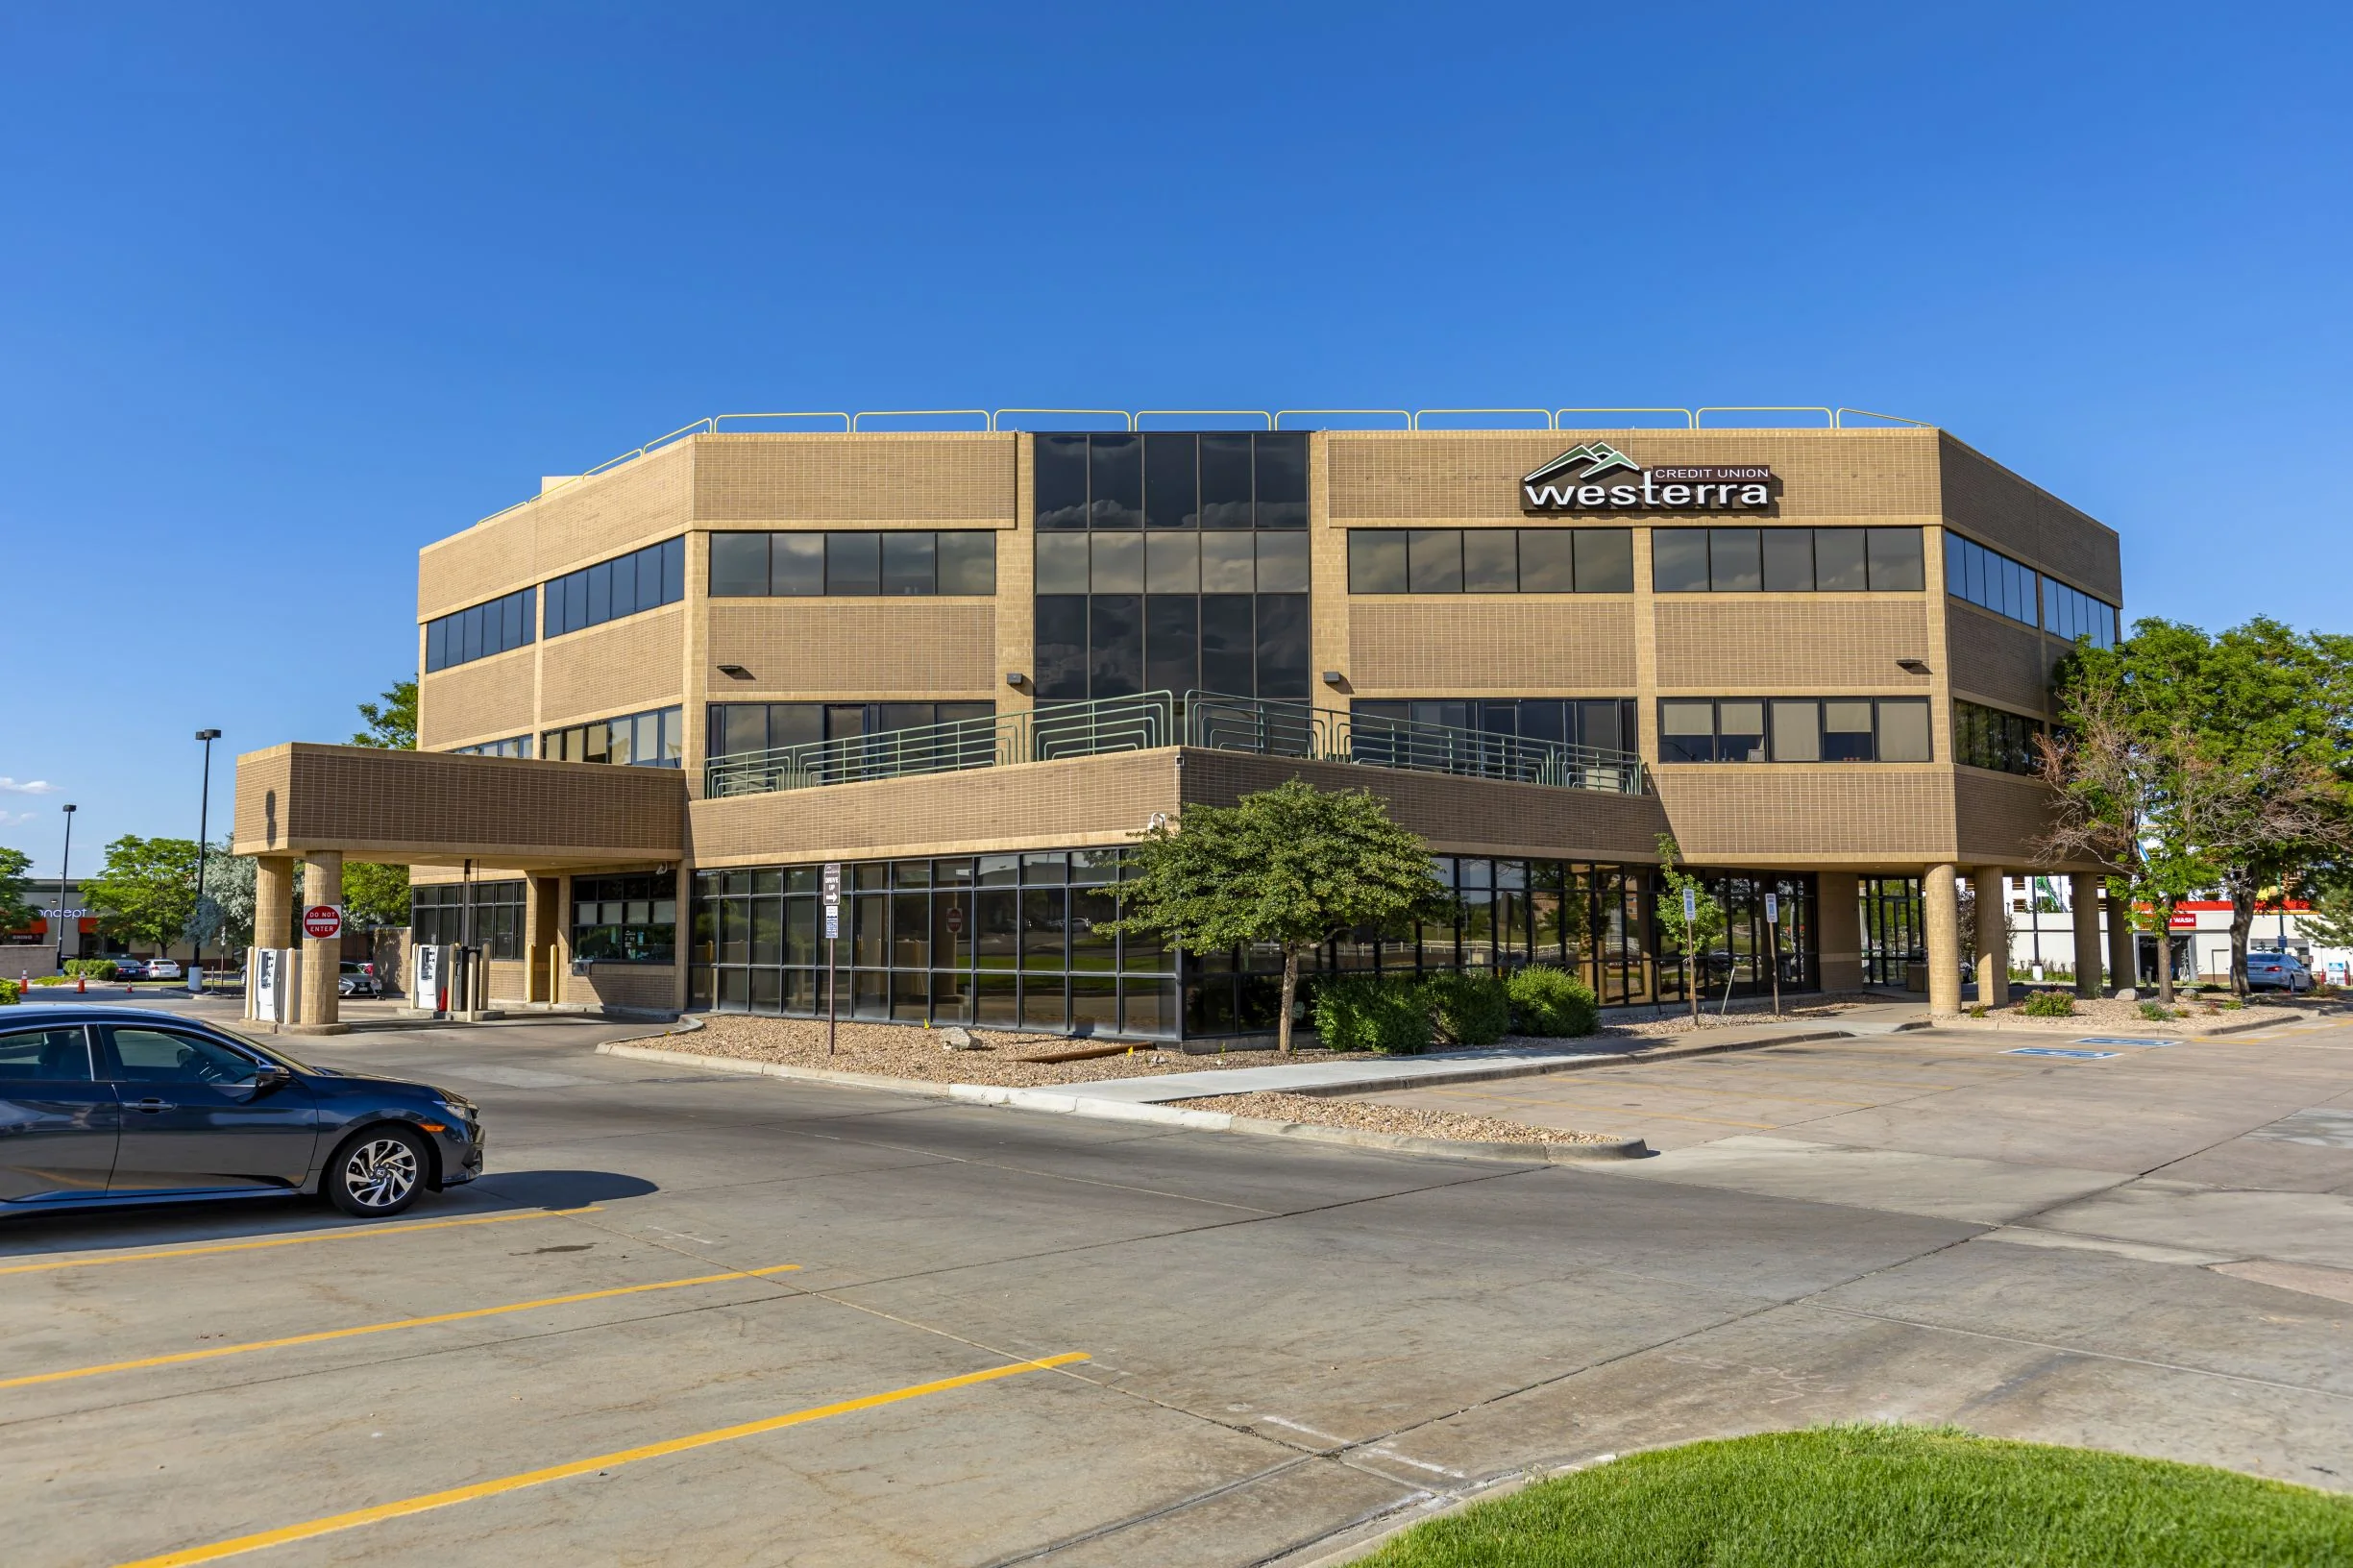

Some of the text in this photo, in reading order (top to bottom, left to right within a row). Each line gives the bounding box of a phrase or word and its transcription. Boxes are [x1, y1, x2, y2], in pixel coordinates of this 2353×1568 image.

[1654, 468, 1769, 478] CREDIT UNION
[1524, 470, 1769, 506] westerra
[37, 908, 87, 919] ncept
